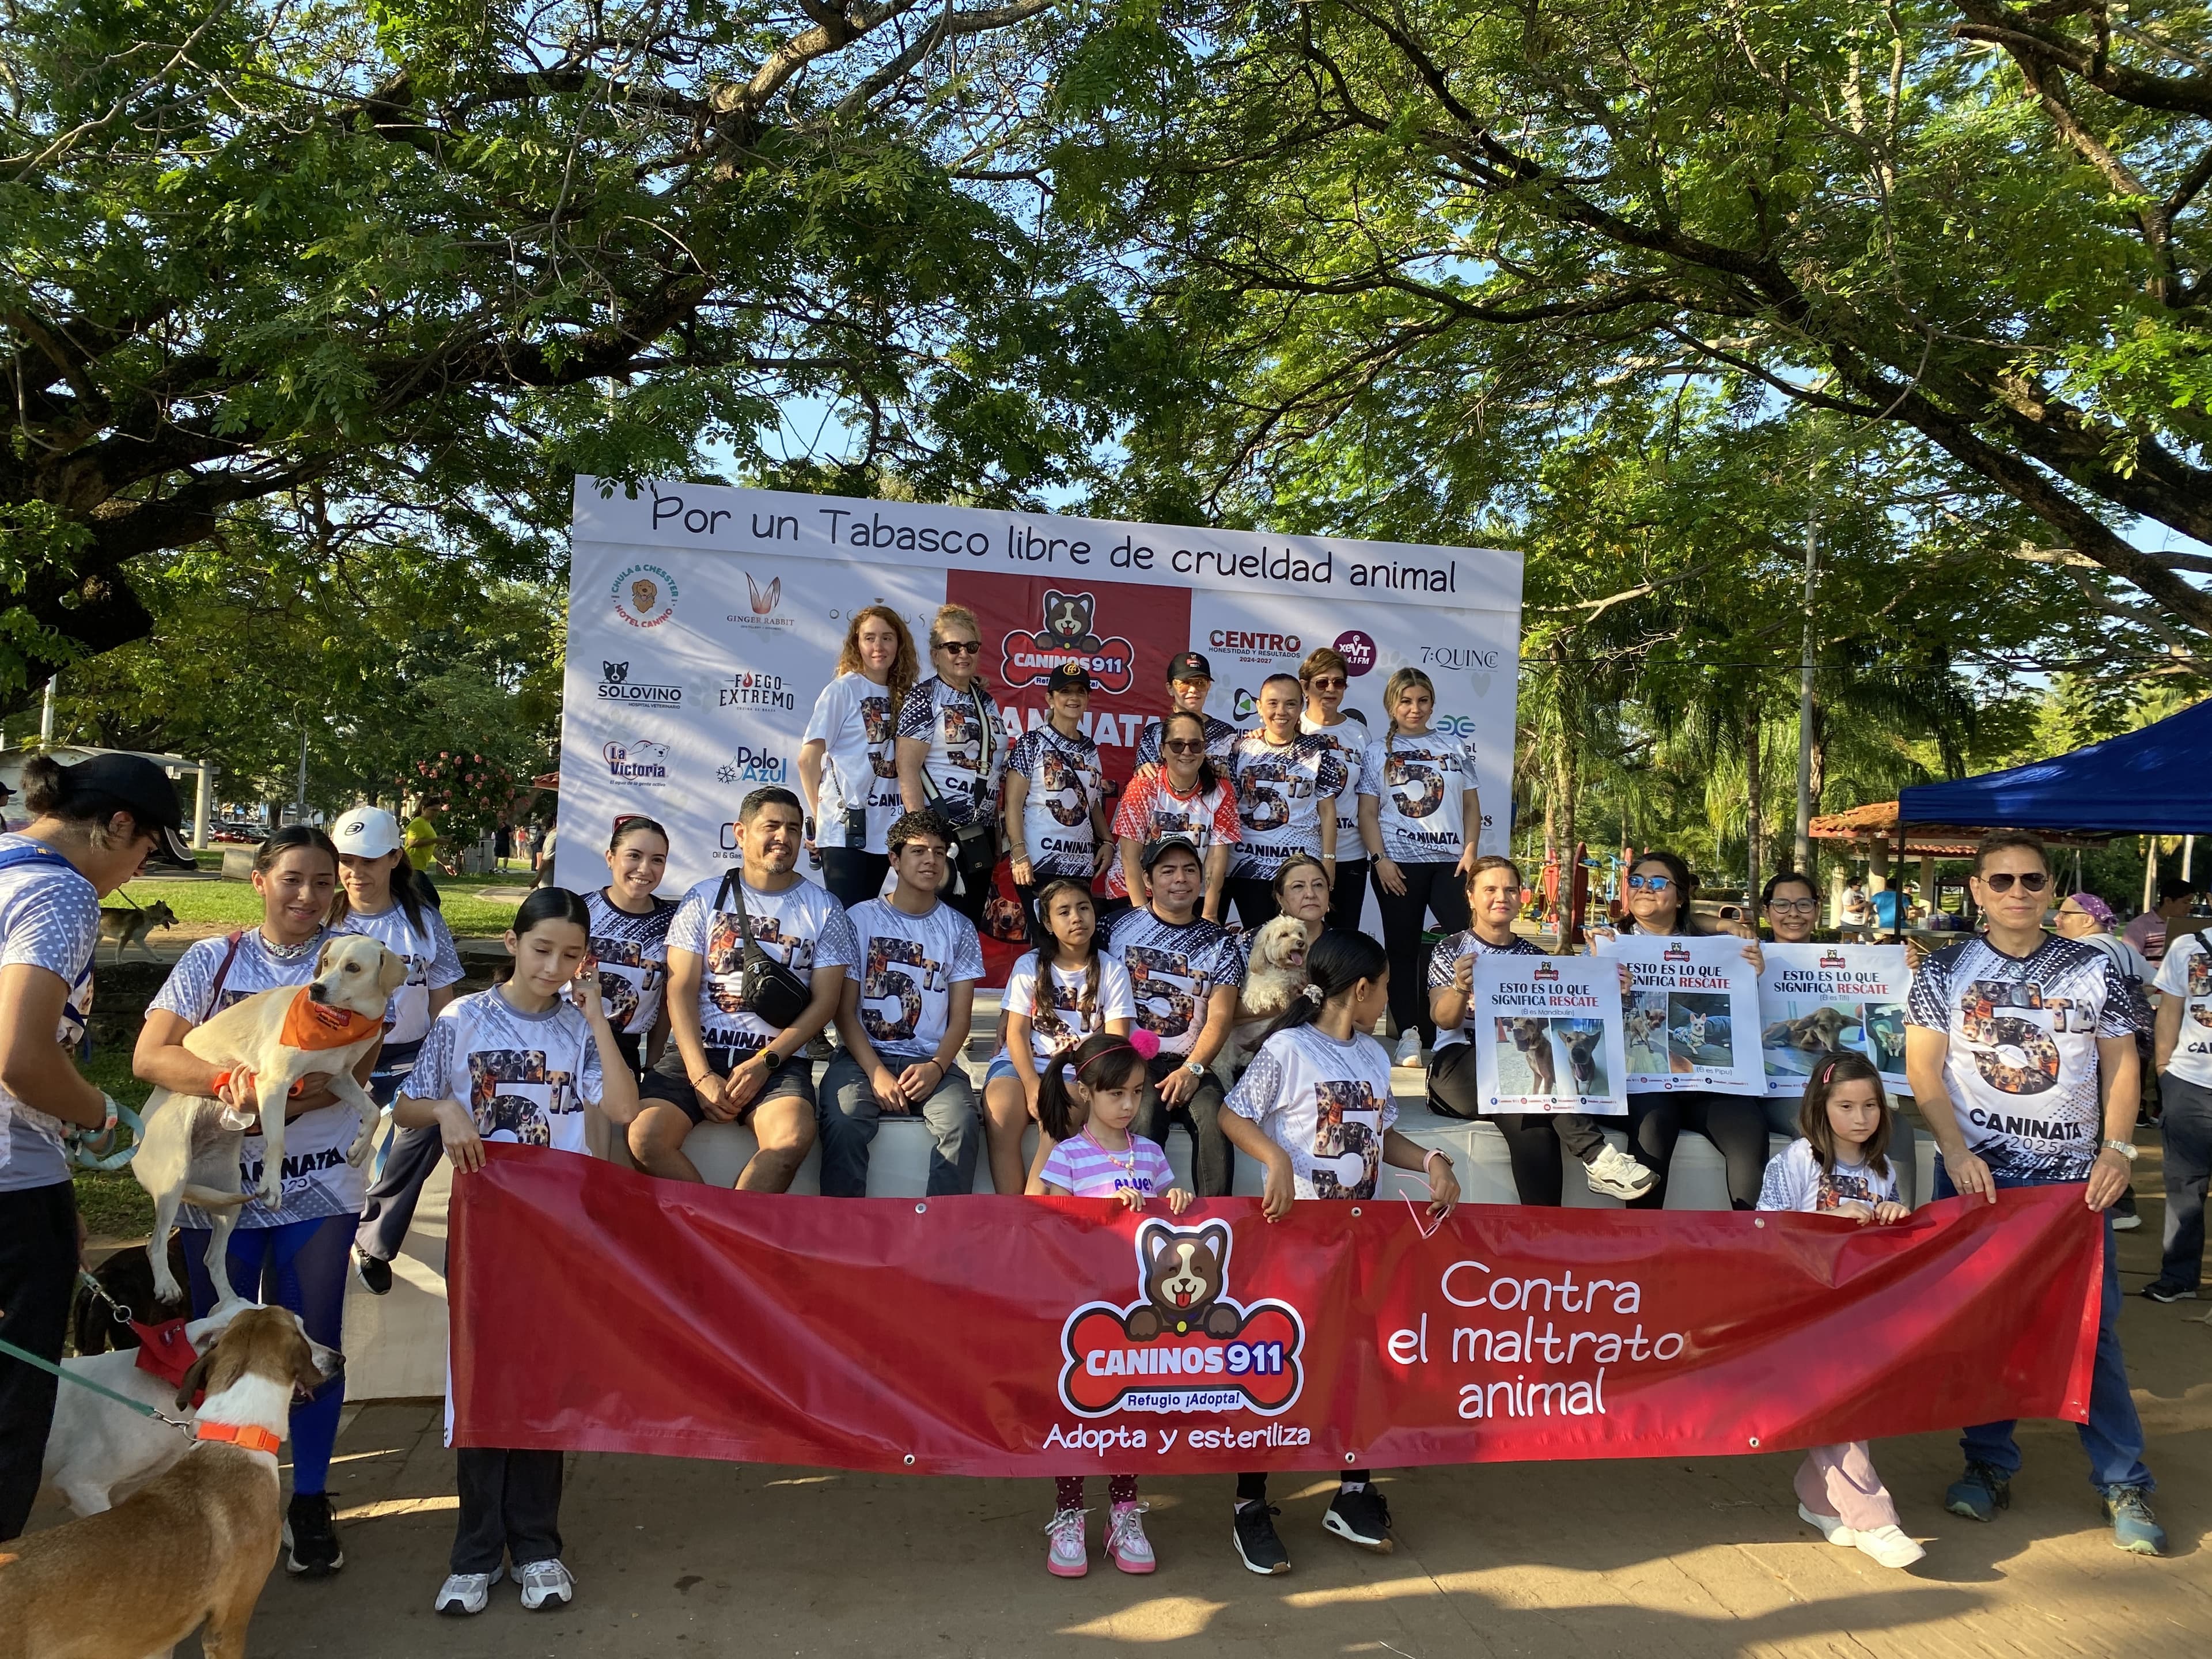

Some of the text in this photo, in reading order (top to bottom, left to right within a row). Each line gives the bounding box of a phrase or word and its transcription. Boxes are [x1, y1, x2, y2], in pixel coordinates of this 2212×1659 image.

[653, 496, 1456, 594] Por un Tabasco libre de crueldad animal
[611, 564, 679, 597] CHULA & CHESSTER
[615, 604, 673, 628] HOTEL CANINO
[727, 615, 794, 626] GINGER RABBIT
[1210, 630, 1301, 652] CENTRO
[1209, 647, 1251, 655] HONESTIDAD
[1258, 650, 1301, 658] RESULTADOS
[1239, 656, 1272, 664] 2024-2027
[1092, 657, 1122, 673] 911
[598, 685, 682, 701] SOLOVINO
[719, 689, 794, 710] EXTREMO
[611, 747, 626, 760] La
[737, 746, 779, 769] Polo
[611, 761, 665, 778] Victoria
[742, 758, 787, 783] Azul
[1396, 828, 1461, 845] CANINATA
[1063, 853, 1086, 862] 2025
[1627, 963, 1722, 978] ESTO ES LO QUE
[1783, 971, 1880, 983] ESTO ES LO QUE
[1500, 983, 1590, 997] ESTO ES LO QUE
[1632, 975, 1732, 989] GNIFICA RESCATE
[1774, 982, 1889, 994] SIGNIFICA RESCATE
[1492, 994, 1599, 1007] SIGNIFICA RESCATE
[1969, 1108, 2084, 1141] CANINATA
[2010, 1136, 2059, 1153] 2025
[1441, 1260, 1641, 1315] Contra
[1387, 1312, 1684, 1365] el maltrato
[1086, 1343, 1282, 1377] CANINOS 911
[1127, 1392, 1240, 1408] Refugio ¡Adopta!
[1458, 1366, 1607, 1419] animal
[1043, 1422, 1312, 1457] Adopta y esteriliza
